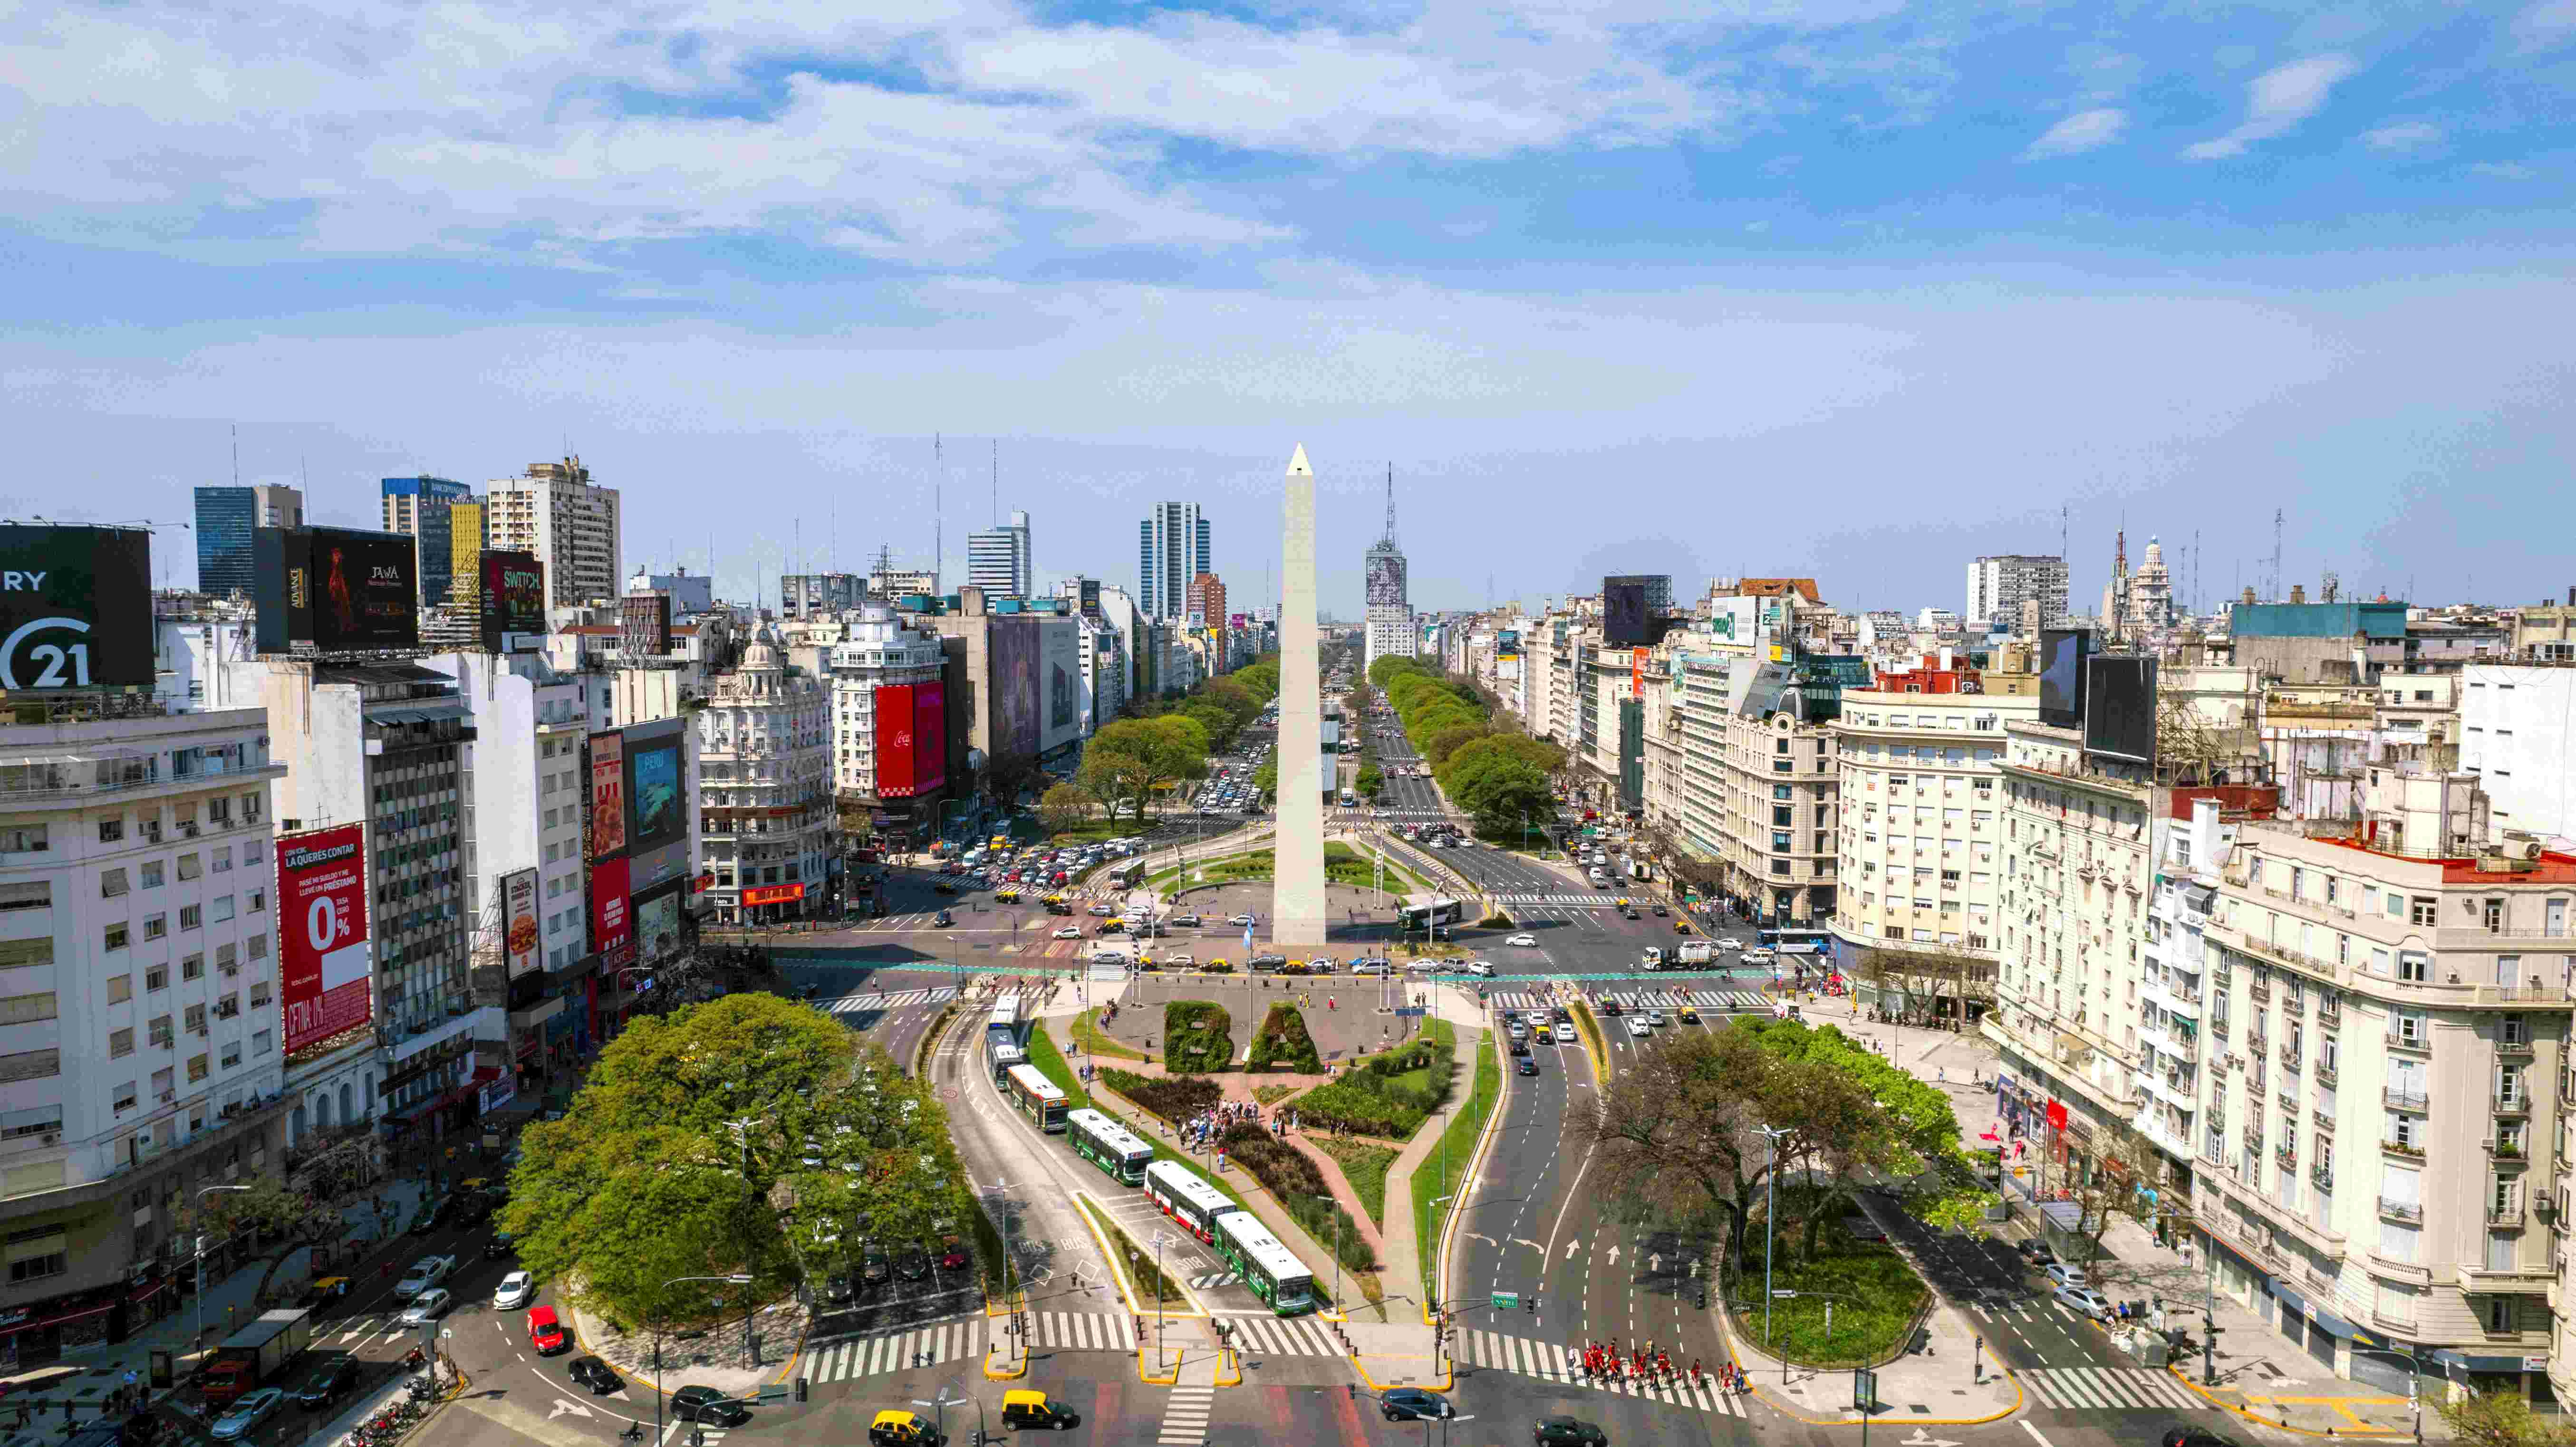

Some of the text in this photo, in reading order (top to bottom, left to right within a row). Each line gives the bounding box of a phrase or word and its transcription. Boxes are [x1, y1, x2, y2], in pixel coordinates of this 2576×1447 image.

[290, 566, 299, 608] ADVANCE
[894, 730, 910, 747] Coca
[286, 844, 354, 867] LA QUERÉS CONTAR
[324, 875, 357, 891] PRÉSTAMO
[1061, 1237, 1090, 1251] BUS
[1175, 1256, 1207, 1270] BUS
